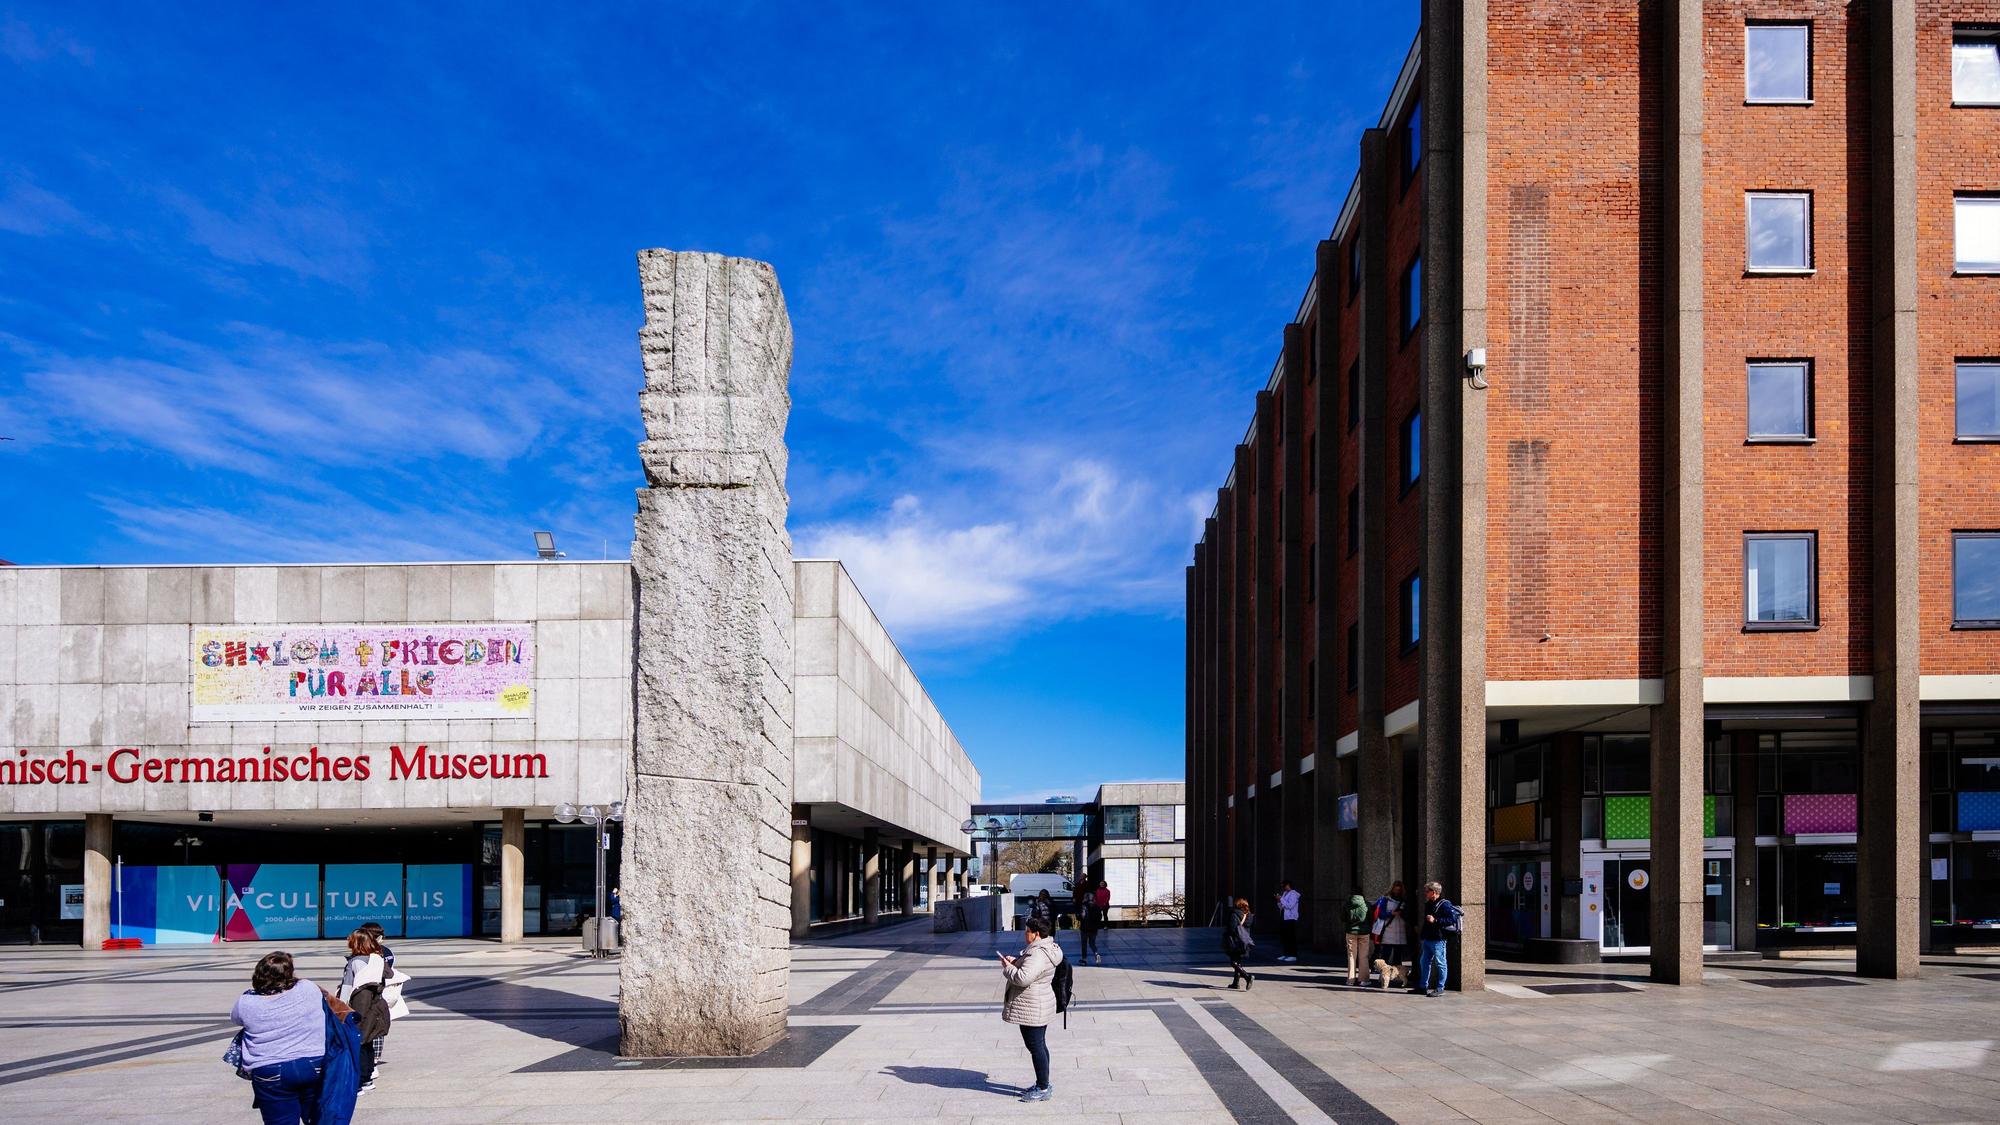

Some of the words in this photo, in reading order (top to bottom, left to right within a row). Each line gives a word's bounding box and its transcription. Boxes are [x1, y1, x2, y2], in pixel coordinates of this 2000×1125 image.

[289, 668, 347, 698] FÜR
[355, 669, 436, 696] ALLE
[353, 703, 433, 711] ZUSAMMENHALT!
[389, 745, 549, 781] Museum
[187, 893, 244, 912] VIA
